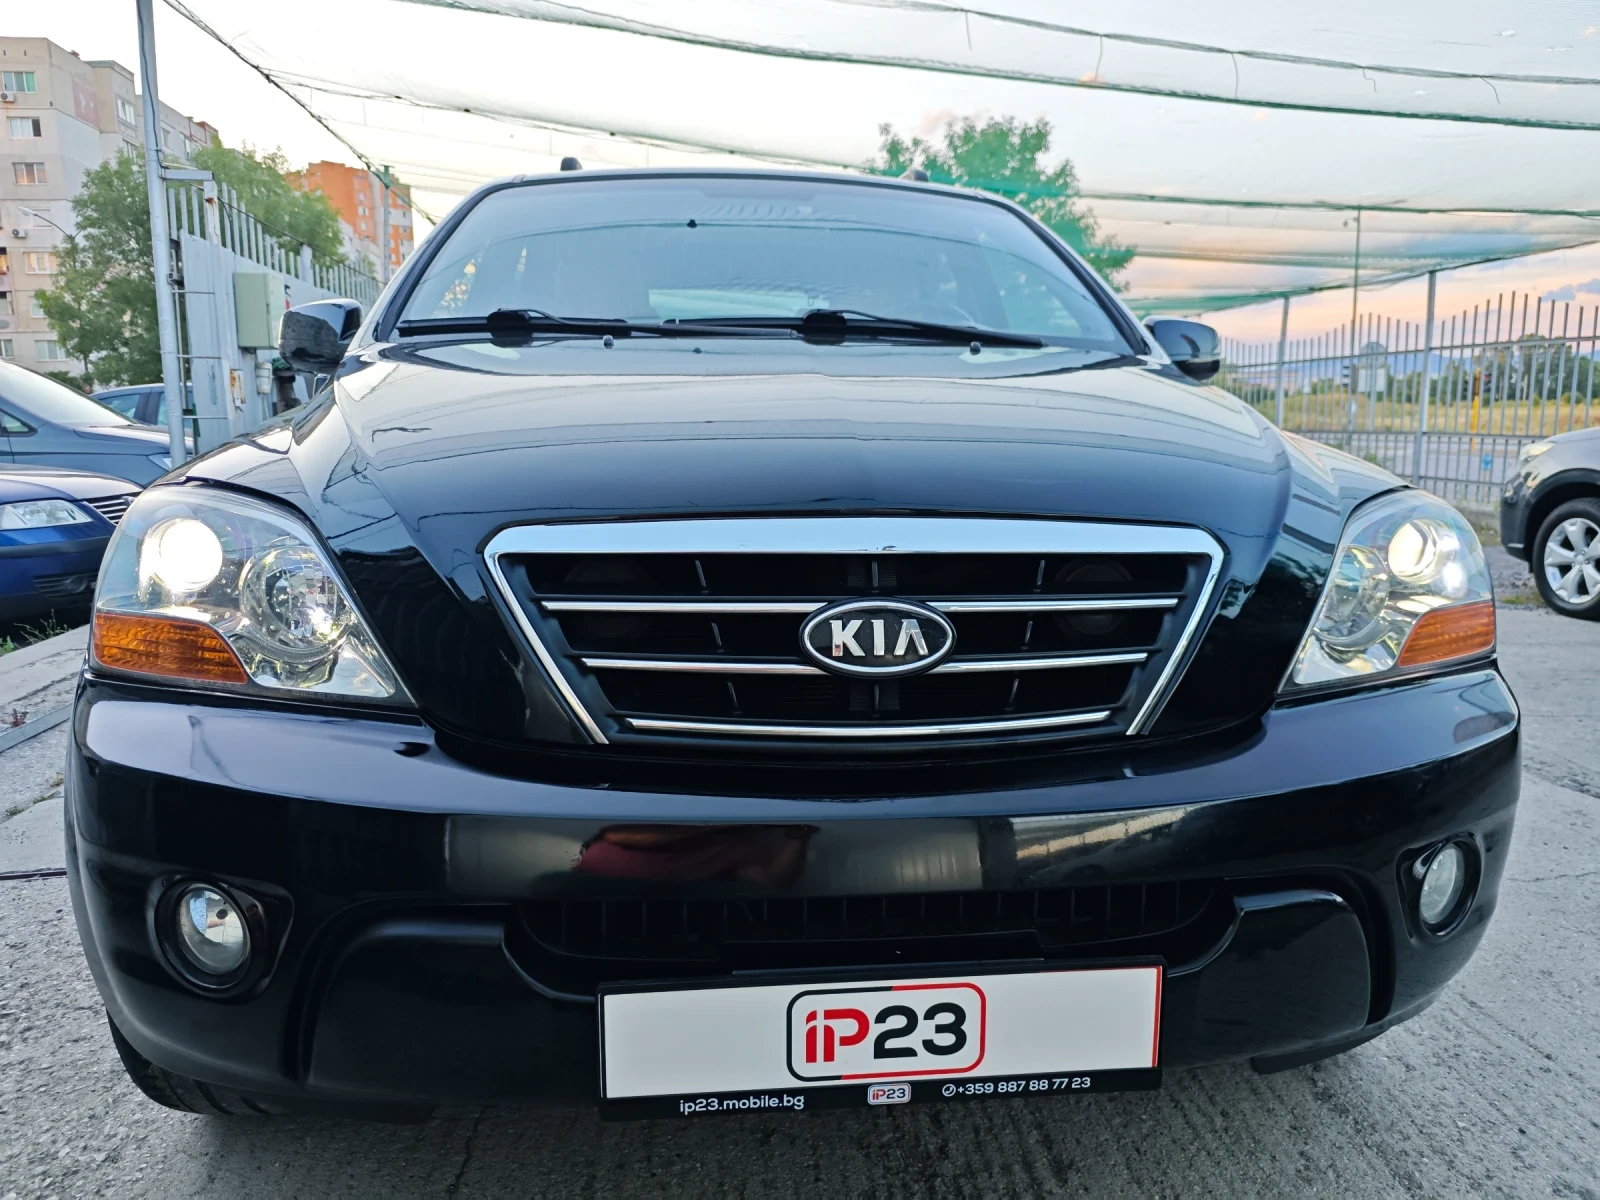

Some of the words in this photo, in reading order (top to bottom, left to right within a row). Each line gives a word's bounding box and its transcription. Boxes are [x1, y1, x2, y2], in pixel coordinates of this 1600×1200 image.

[829, 618, 929, 657] KIA
[957, 1082, 994, 1095] +359
[997, 1080, 1027, 1093] 887
[1029, 1079, 1049, 1091] 88
[1052, 1077, 1069, 1090] 77
[1071, 1076, 1091, 1088] 23
[679, 1094, 805, 1116] ip23.mobile.bg
